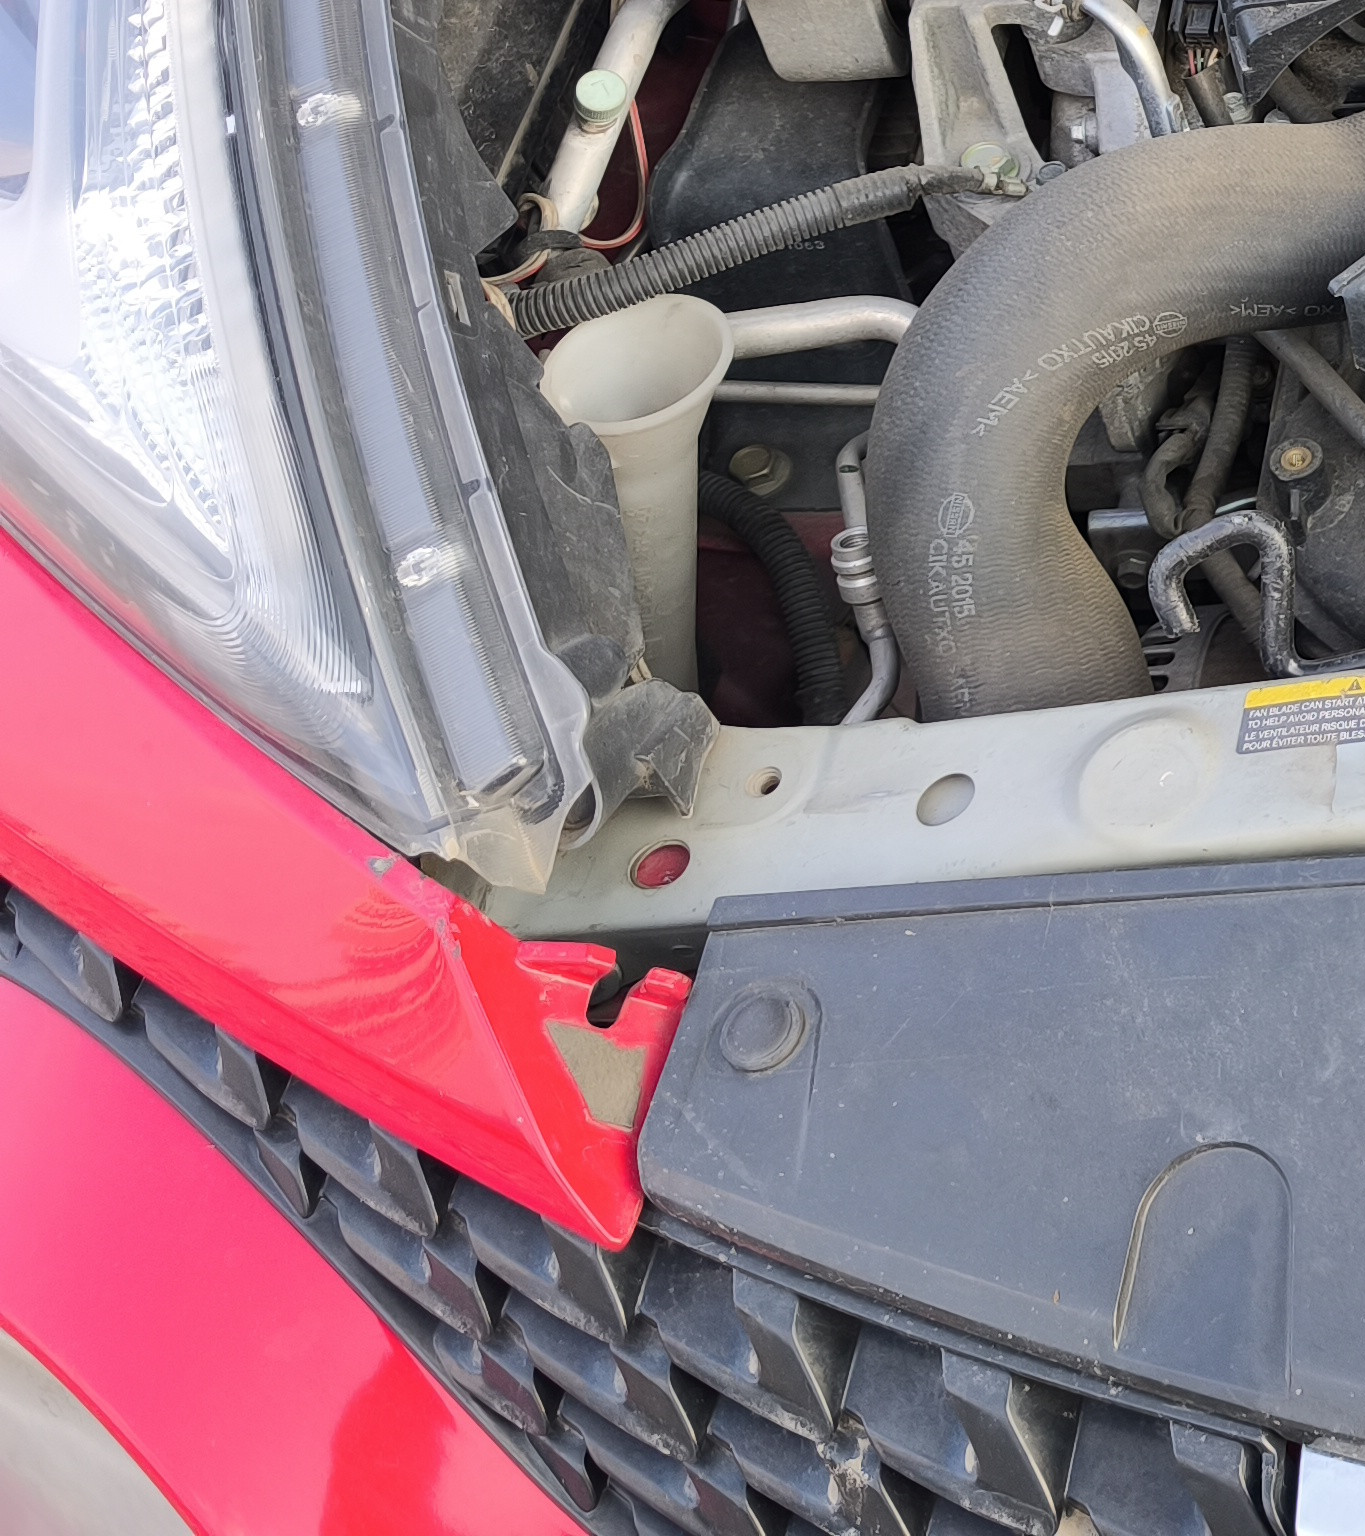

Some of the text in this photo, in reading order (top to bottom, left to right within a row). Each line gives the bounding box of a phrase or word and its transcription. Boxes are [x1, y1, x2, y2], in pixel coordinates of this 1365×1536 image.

[1269, 705, 1299, 715] BLADE
[1302, 702, 1321, 710] CAN
[1325, 698, 1352, 708] START
[1248, 720, 1260, 728] TO
[1262, 717, 1287, 726] HELP
[1288, 713, 1316, 723] AVOID
[1245, 732, 1257, 740] LE
[1259, 724, 1319, 739] VENTILATEUR
[1321, 720, 1358, 731] RISQUE
[1243, 740, 1270, 751] POUR
[1272, 735, 1305, 747] ÉVITER
[1307, 732, 1338, 743] TOUTE
